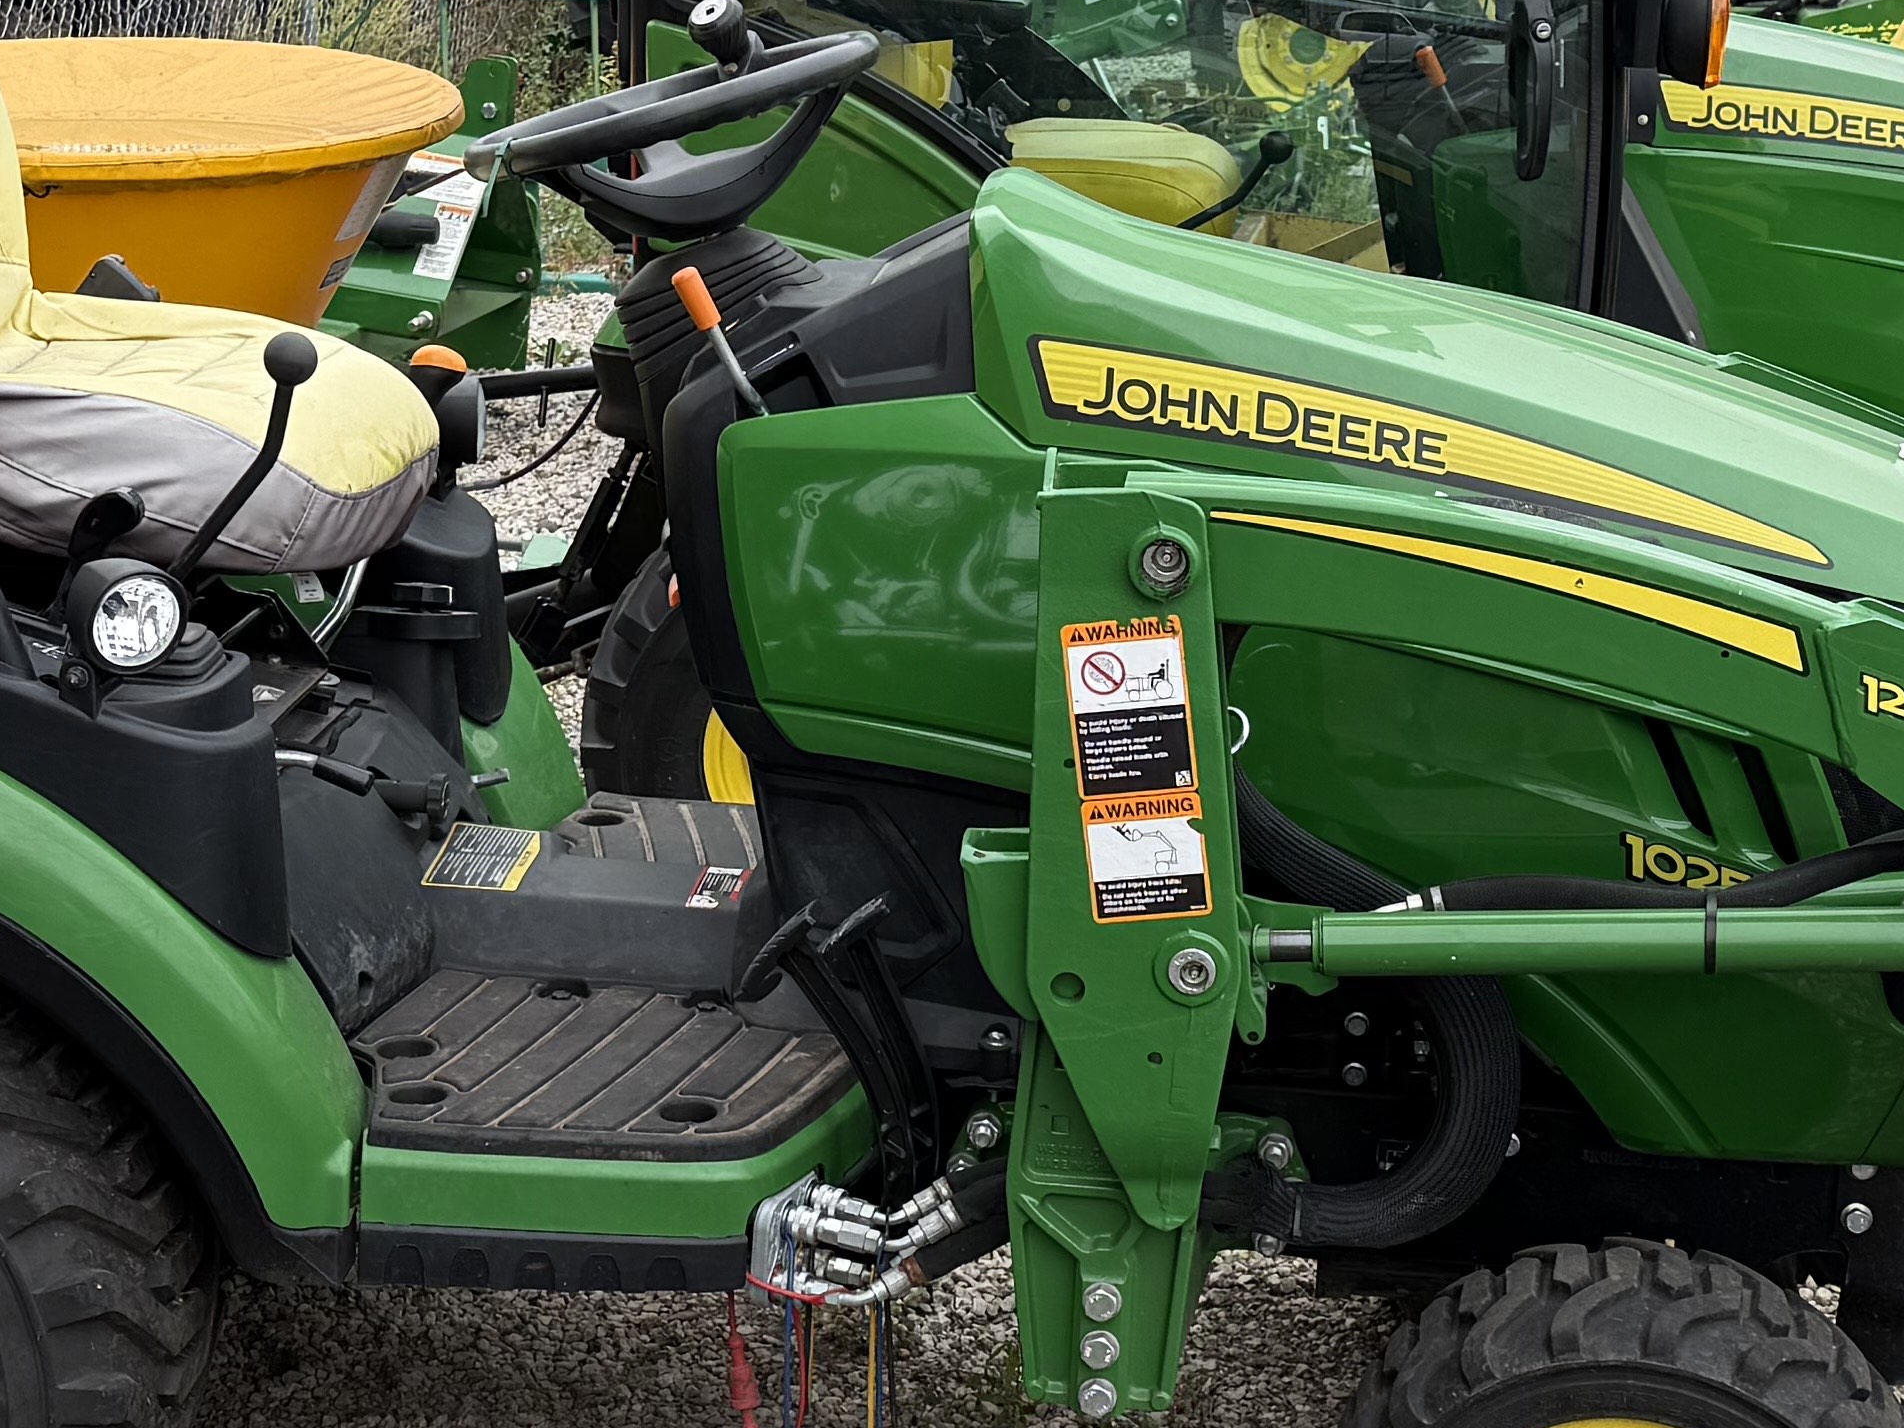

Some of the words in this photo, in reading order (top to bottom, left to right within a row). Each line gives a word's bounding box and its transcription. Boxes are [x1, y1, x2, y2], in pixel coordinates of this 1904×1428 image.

[1691, 95, 1798, 133] JOHN
[1082, 364, 1240, 434] JOHN
[1254, 389, 1448, 472] DEERE
[1084, 619, 1176, 642] WARNING
[1105, 797, 1195, 818] WARNING
